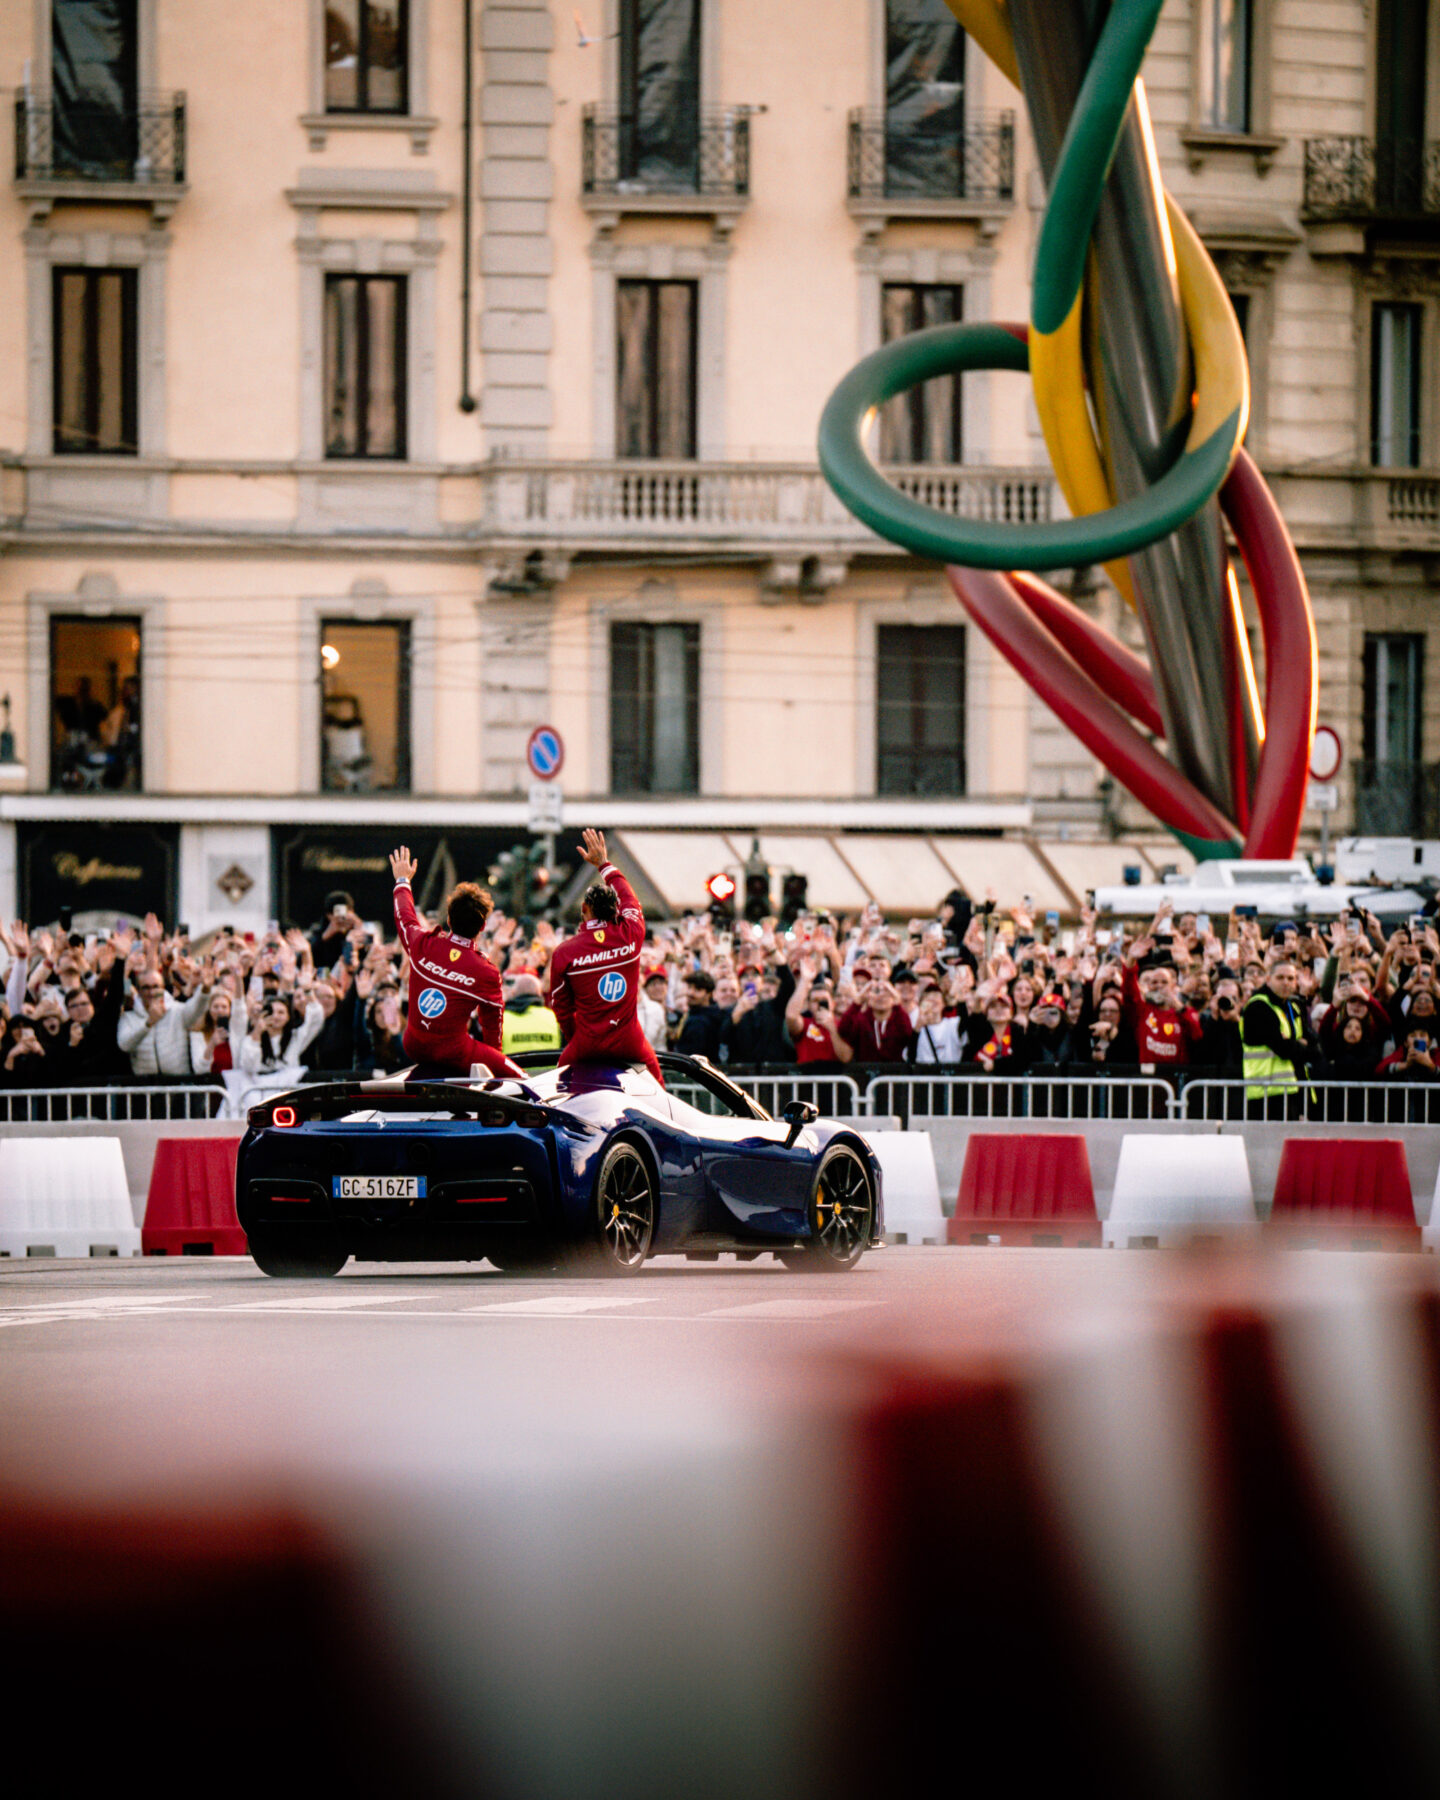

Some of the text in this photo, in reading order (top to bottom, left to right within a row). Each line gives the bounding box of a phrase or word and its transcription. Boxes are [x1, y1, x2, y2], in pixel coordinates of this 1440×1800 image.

[572, 941, 636, 967] HAMILTON
[418, 957, 476, 986] LECLERC
[600, 972, 625, 1002] hp
[419, 988, 446, 1018] hp
